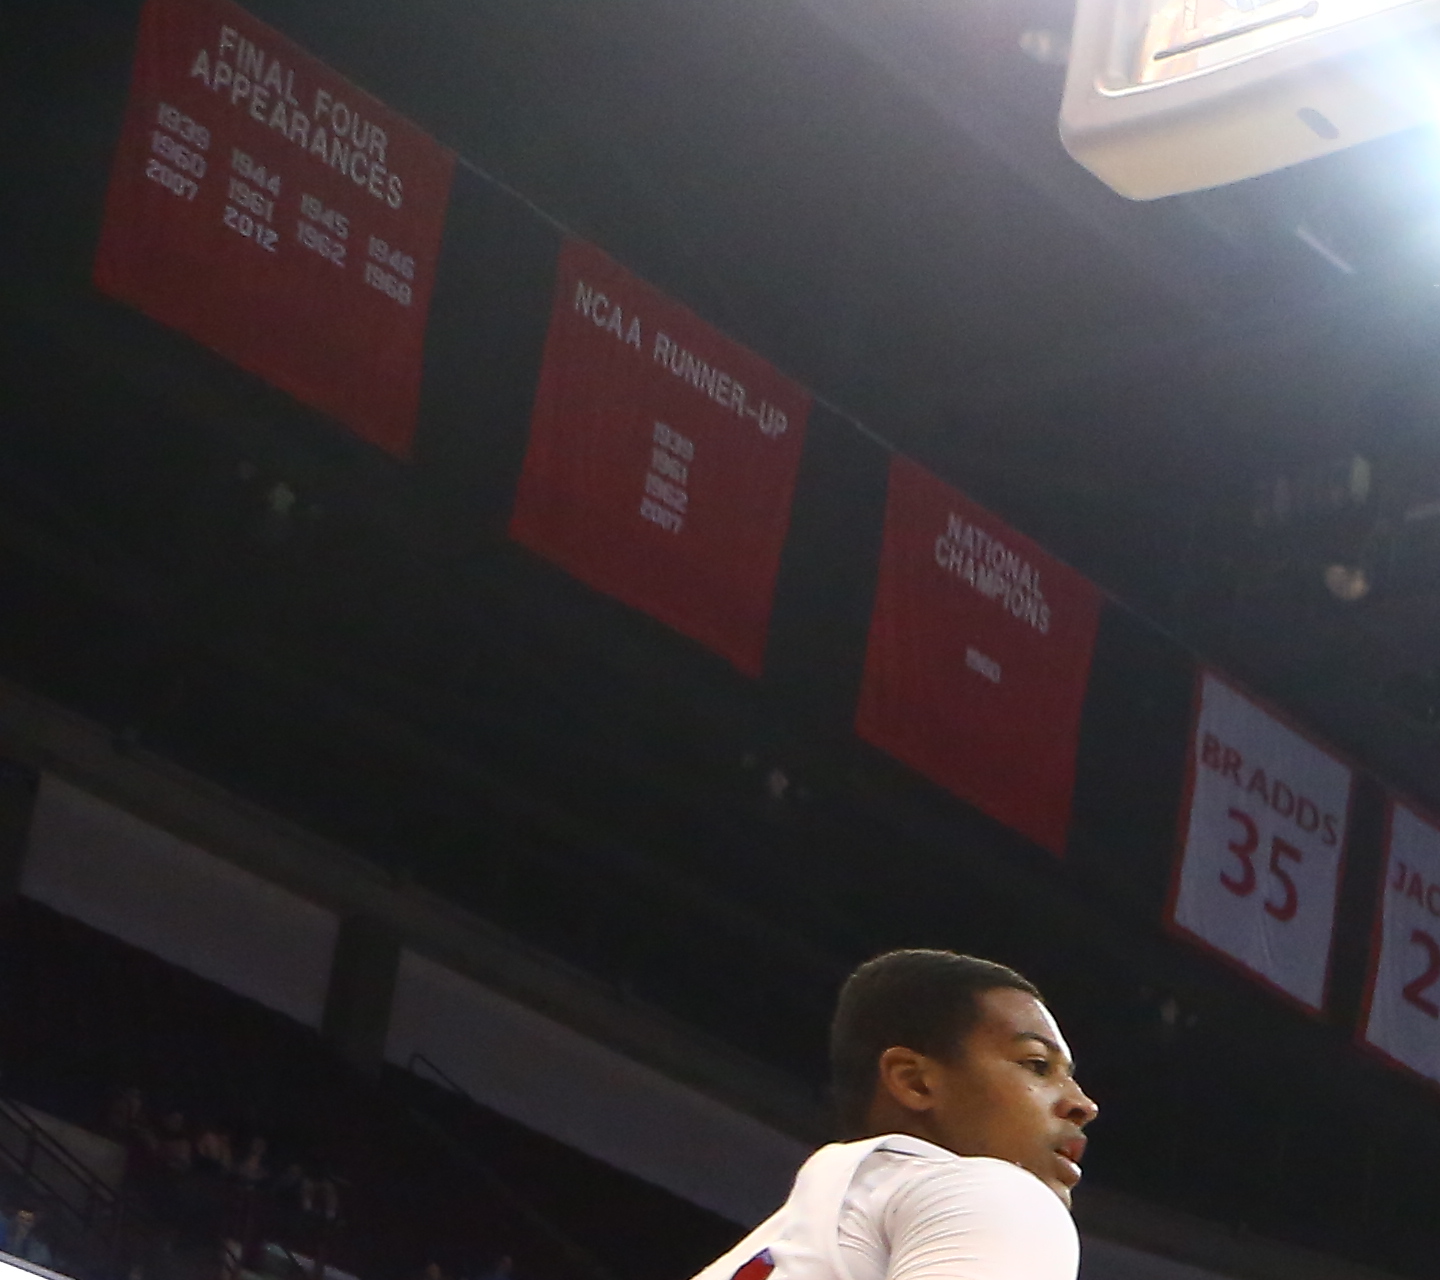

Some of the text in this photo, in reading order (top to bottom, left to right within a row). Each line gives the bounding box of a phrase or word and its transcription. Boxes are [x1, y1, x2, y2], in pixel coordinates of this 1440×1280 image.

[191, 48, 403, 209] APPEARANCES
[219, 25, 387, 163] FINAL FOUR
[222, 205, 279, 252] 2012
[574, 280, 788, 438] NCAA RUNNER-UP
[935, 535, 1051, 635] CHAMPIONS
[947, 511, 1042, 598] NATIONAL
[1200, 734, 1337, 846] BRADDS
[1220, 807, 1302, 921] 35
